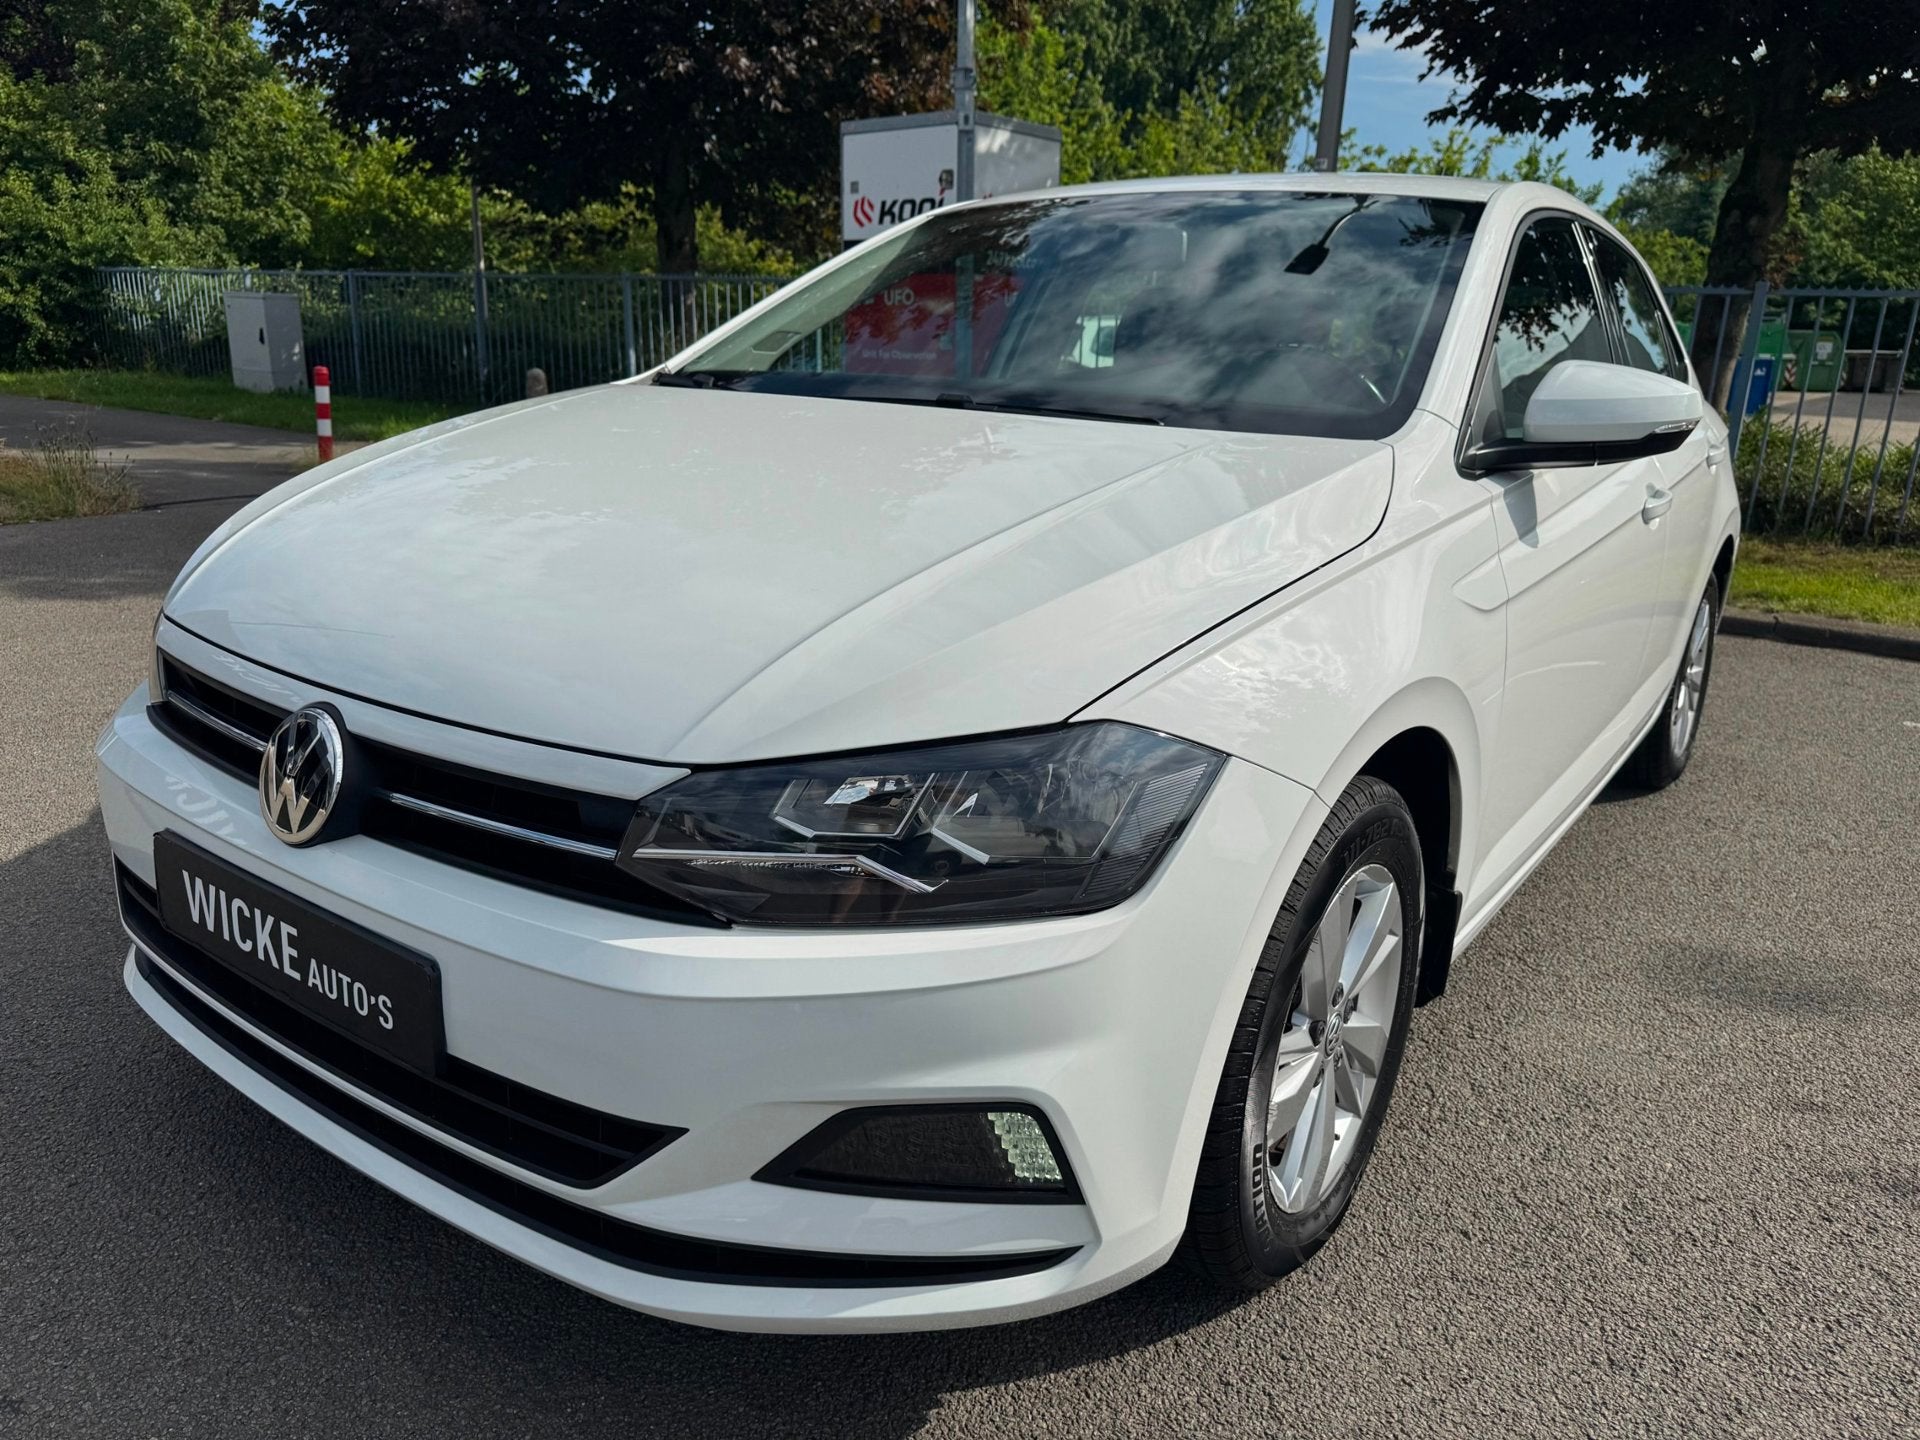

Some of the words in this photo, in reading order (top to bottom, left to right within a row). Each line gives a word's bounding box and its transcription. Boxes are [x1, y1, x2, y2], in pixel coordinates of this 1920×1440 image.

[884, 287, 915, 306] UFO
[182, 869, 301, 981] WICKE
[307, 957, 394, 1030] AUTO'S
